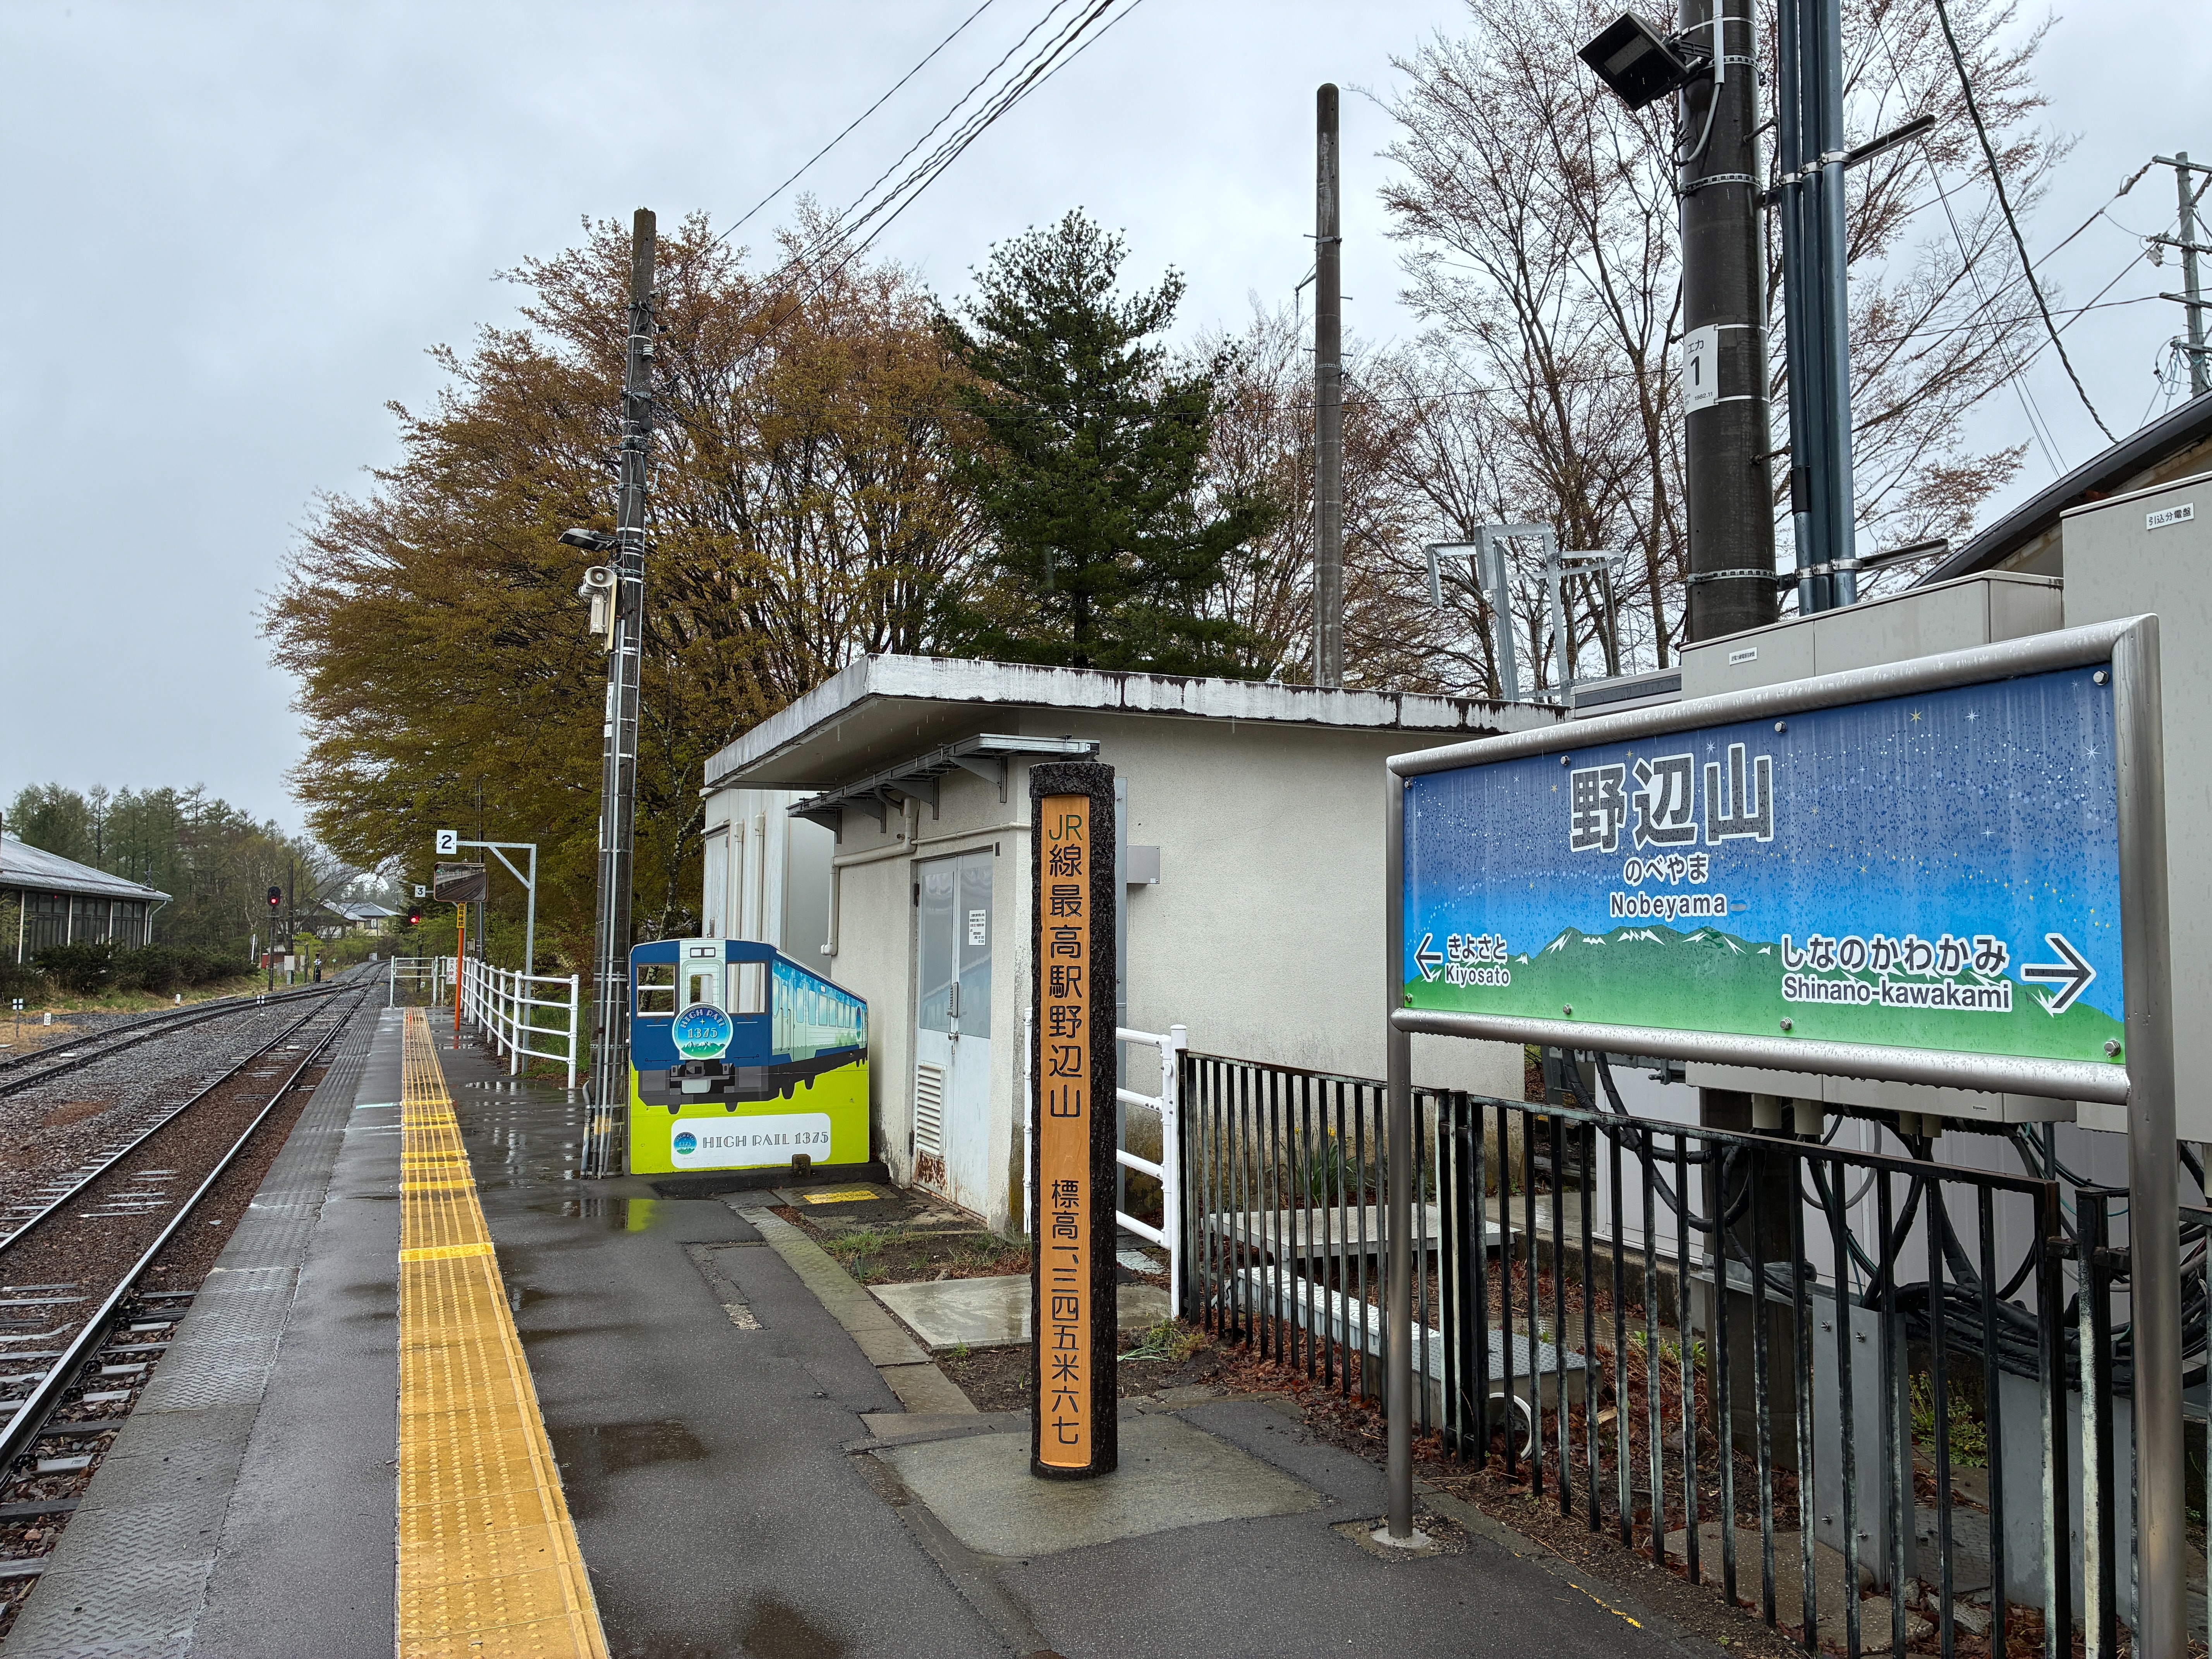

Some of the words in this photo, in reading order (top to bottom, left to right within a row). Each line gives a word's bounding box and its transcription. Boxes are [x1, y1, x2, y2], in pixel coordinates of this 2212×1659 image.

[1690, 356, 1700, 386] 1
[1695, 392, 1713, 400] 1982.11
[1571, 745, 1772, 850] 野辺山
[441, 835, 452, 849] 2
[1626, 854, 1707, 883] のべやま
[1611, 893, 1726, 919] Nobeyama
[1448, 935, 1506, 960] きよさと
[1783, 937, 2007, 973] しなのかわかみ
[1049, 814, 1083, 1118] JR線最高駅野辺山
[1446, 964, 1510, 986] Kiyosato
[1783, 975, 2009, 1008] Shinano-kawakami
[680, 1009, 703, 1028] HIGH
[706, 1010, 725, 1028] RAIL
[687, 1027, 718, 1038] 1375
[703, 1135, 747, 1148] HIGH
[752, 1133, 789, 1146] RAIL
[795, 1132, 828, 1144] 1375
